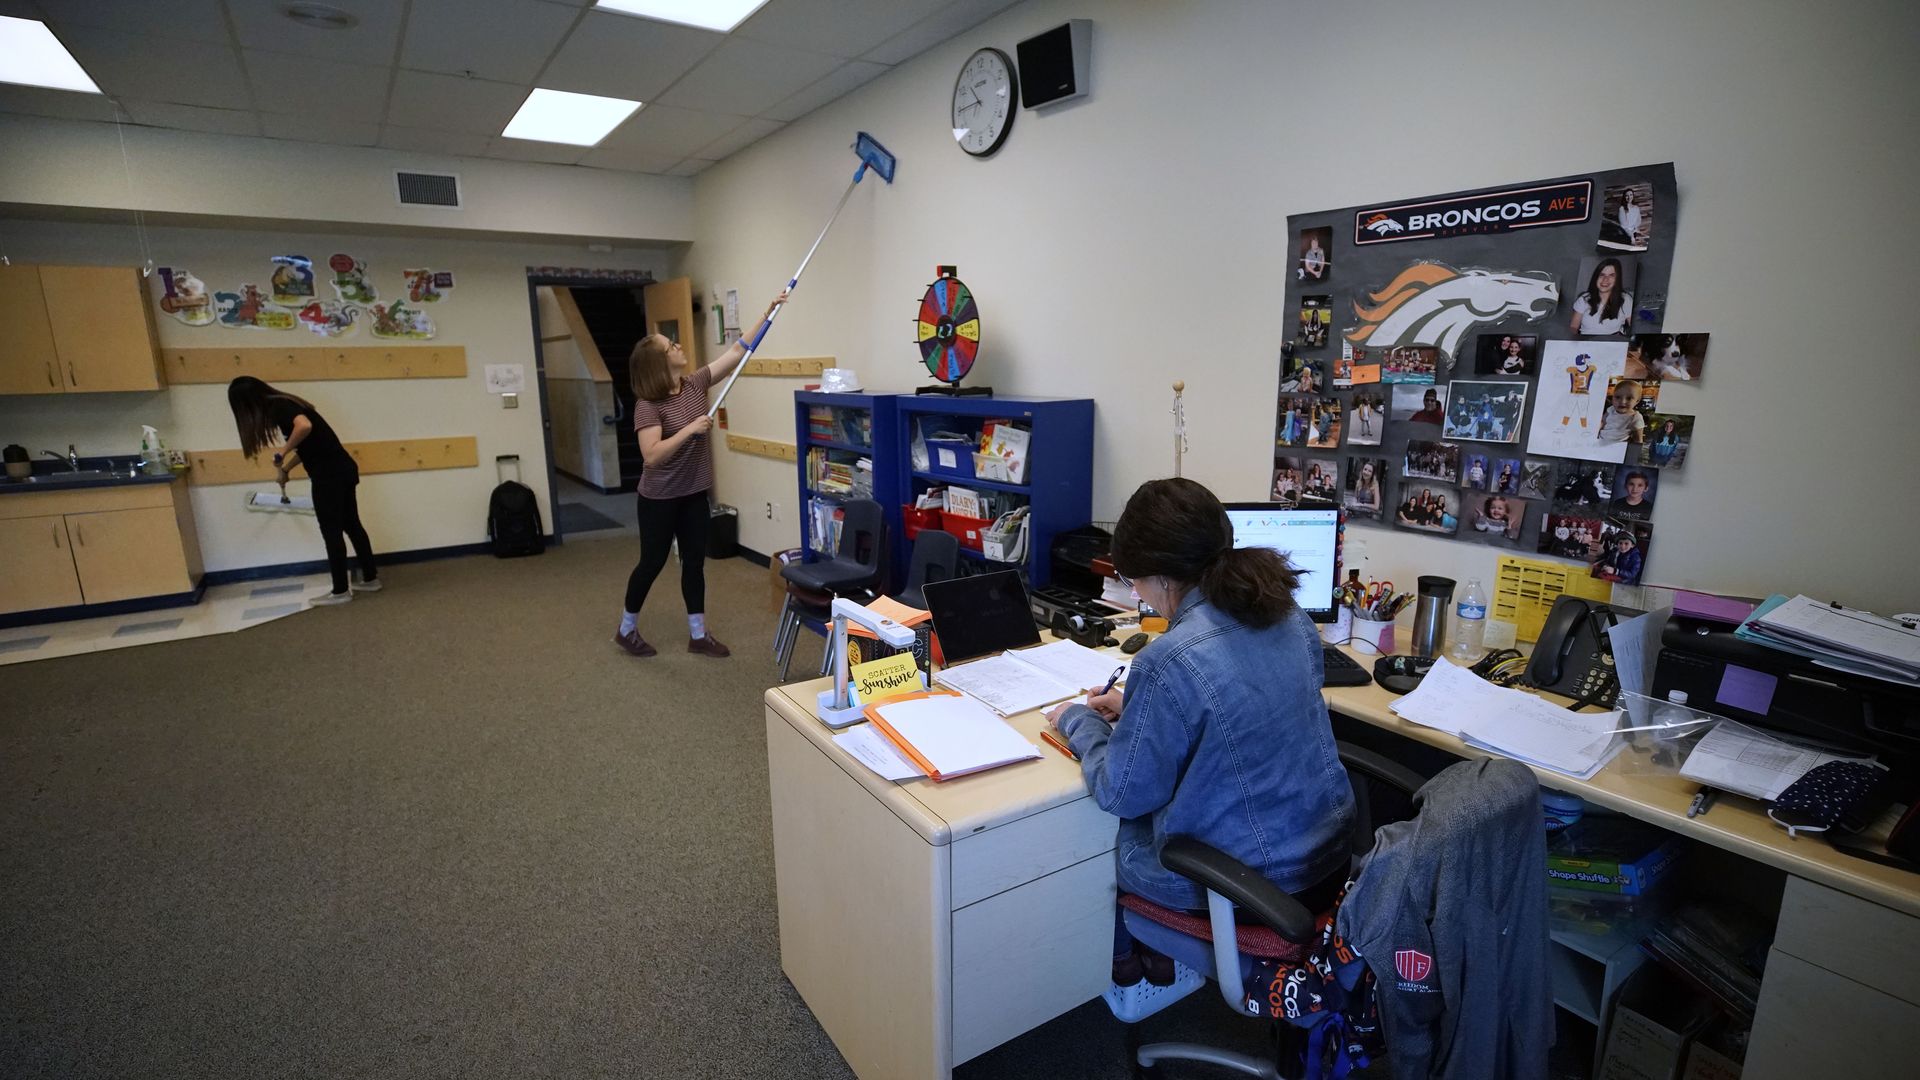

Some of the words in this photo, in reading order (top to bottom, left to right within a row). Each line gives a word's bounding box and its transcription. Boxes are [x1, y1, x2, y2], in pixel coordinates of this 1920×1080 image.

[1408, 199, 1541, 231] BRONCOS
[1548, 197, 1575, 211] AVE
[868, 664, 906, 680] SCATTER
[1548, 869, 1577, 880] Shape
[1577, 872, 1610, 884] Shuffle
[1417, 961, 1426, 973] F
